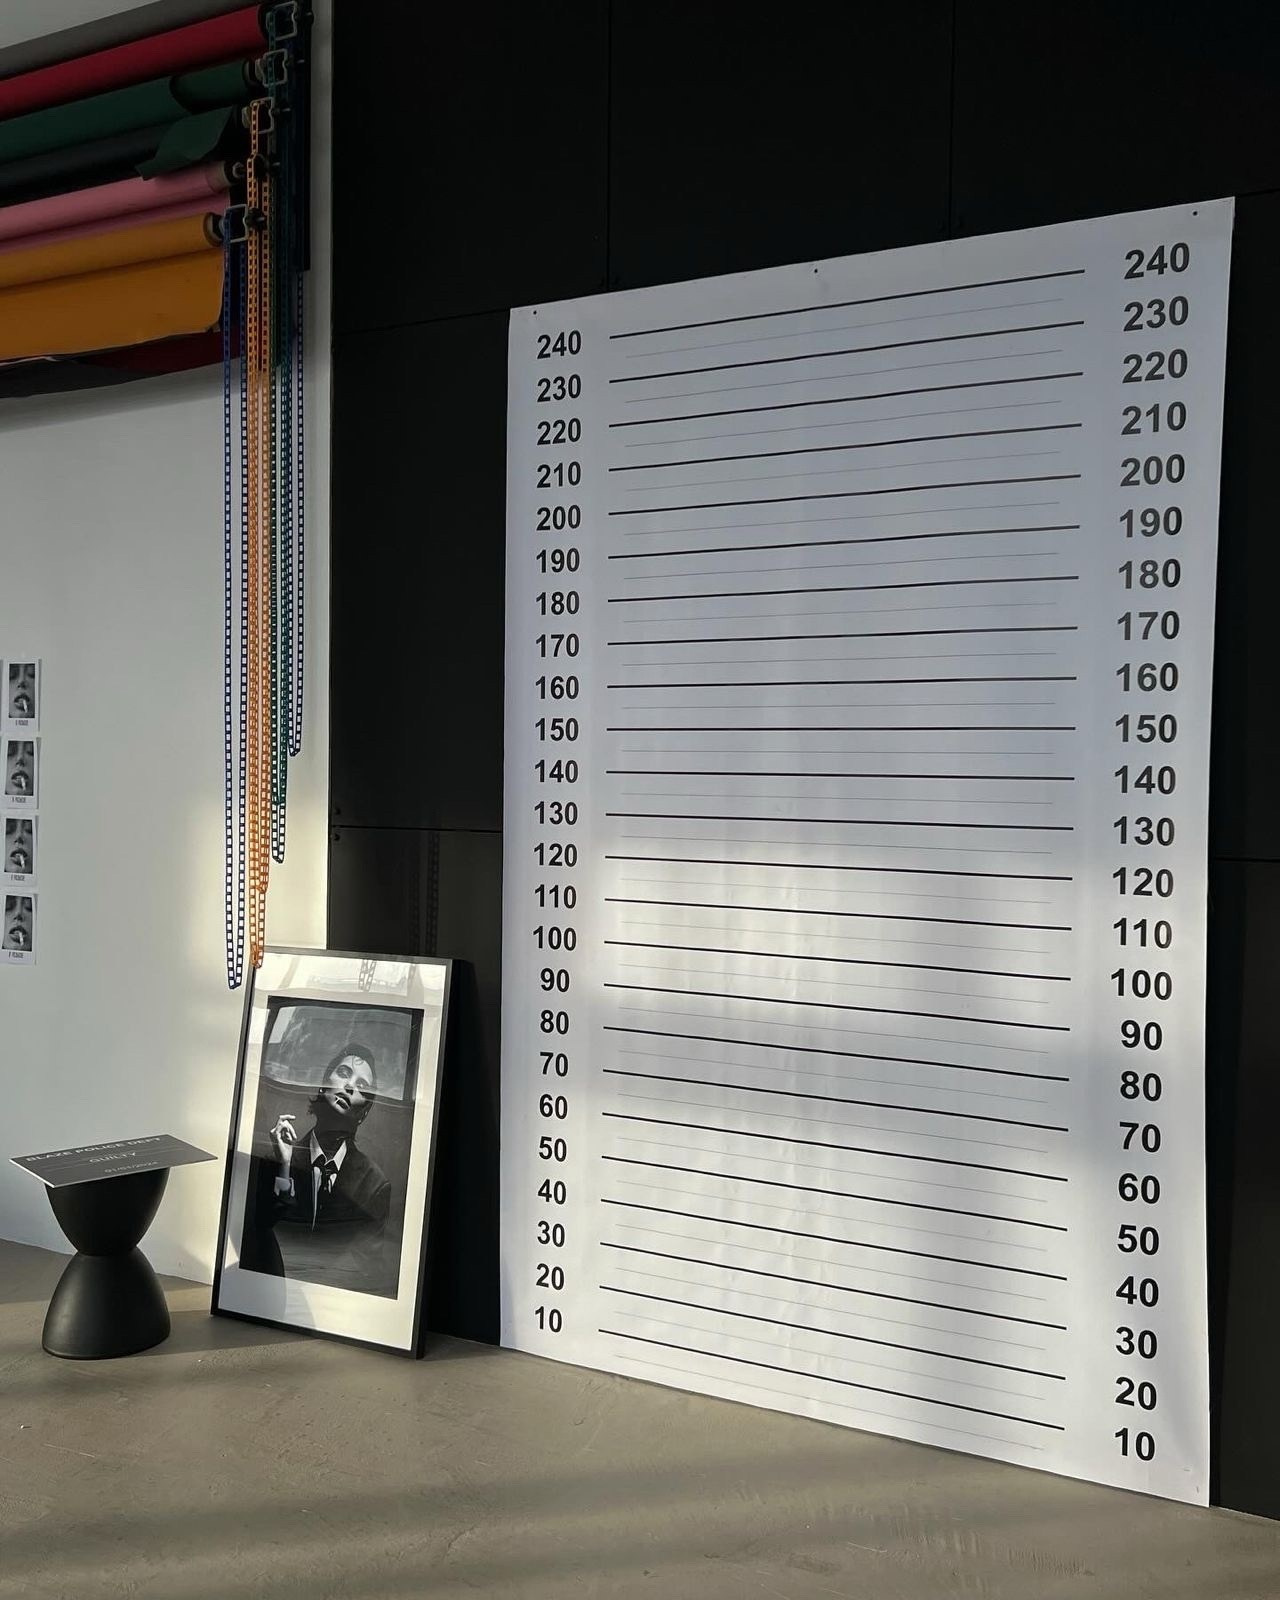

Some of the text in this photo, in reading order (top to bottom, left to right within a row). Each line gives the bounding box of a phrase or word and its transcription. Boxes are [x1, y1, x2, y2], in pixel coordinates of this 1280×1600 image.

[1123, 242, 1190, 280] 240
[1122, 295, 1189, 332] 230
[536, 329, 582, 360] 240
[1121, 348, 1188, 384] 220
[536, 373, 582, 403] 230
[536, 417, 582, 446] 220
[1120, 401, 1187, 436] 210
[536, 460, 582, 489] 210
[1119, 453, 1186, 487] 200
[535, 504, 581, 532] 200
[1119, 506, 1183, 538] 190
[535, 547, 580, 574] 190
[1118, 558, 1181, 590] 180
[535, 590, 580, 616] 180
[1117, 610, 1180, 641] 170
[535, 633, 580, 658] 170
[535, 675, 580, 700] 160
[1116, 662, 1179, 692] 160
[534, 717, 579, 742] 150
[1115, 713, 1178, 744] 150
[534, 759, 579, 784] 140
[1114, 764, 1176, 795] 140
[534, 800, 578, 826] 130
[1113, 815, 1175, 847] 130
[533, 842, 578, 868] 120
[534, 883, 577, 910] 110
[1112, 866, 1174, 898] 120
[532, 925, 577, 952] 100
[1113, 917, 1173, 949] 110
[540, 967, 570, 993] 90
[1110, 967, 1173, 1001] 100
[539, 1009, 570, 1036] 80
[1120, 1019, 1163, 1051] 90
[539, 1051, 569, 1078] 70
[1119, 1070, 1162, 1102] 80
[539, 1093, 568, 1120] 60
[26, 1137, 161, 1162] BLAZE POLICE DEPT
[538, 1135, 567, 1163] 50
[1119, 1121, 1162, 1153] 70
[88, 1151, 137, 1163] GUILTY
[537, 1178, 567, 1206] 40
[1118, 1172, 1161, 1205] 60
[536, 1220, 566, 1248] 30
[1116, 1223, 1160, 1256] 50
[535, 1262, 565, 1291] 20
[1115, 1275, 1160, 1308] 40
[534, 1305, 563, 1333] 10
[1115, 1326, 1158, 1360] 30
[1114, 1376, 1157, 1411] 20
[1114, 1427, 1156, 1462] 10
